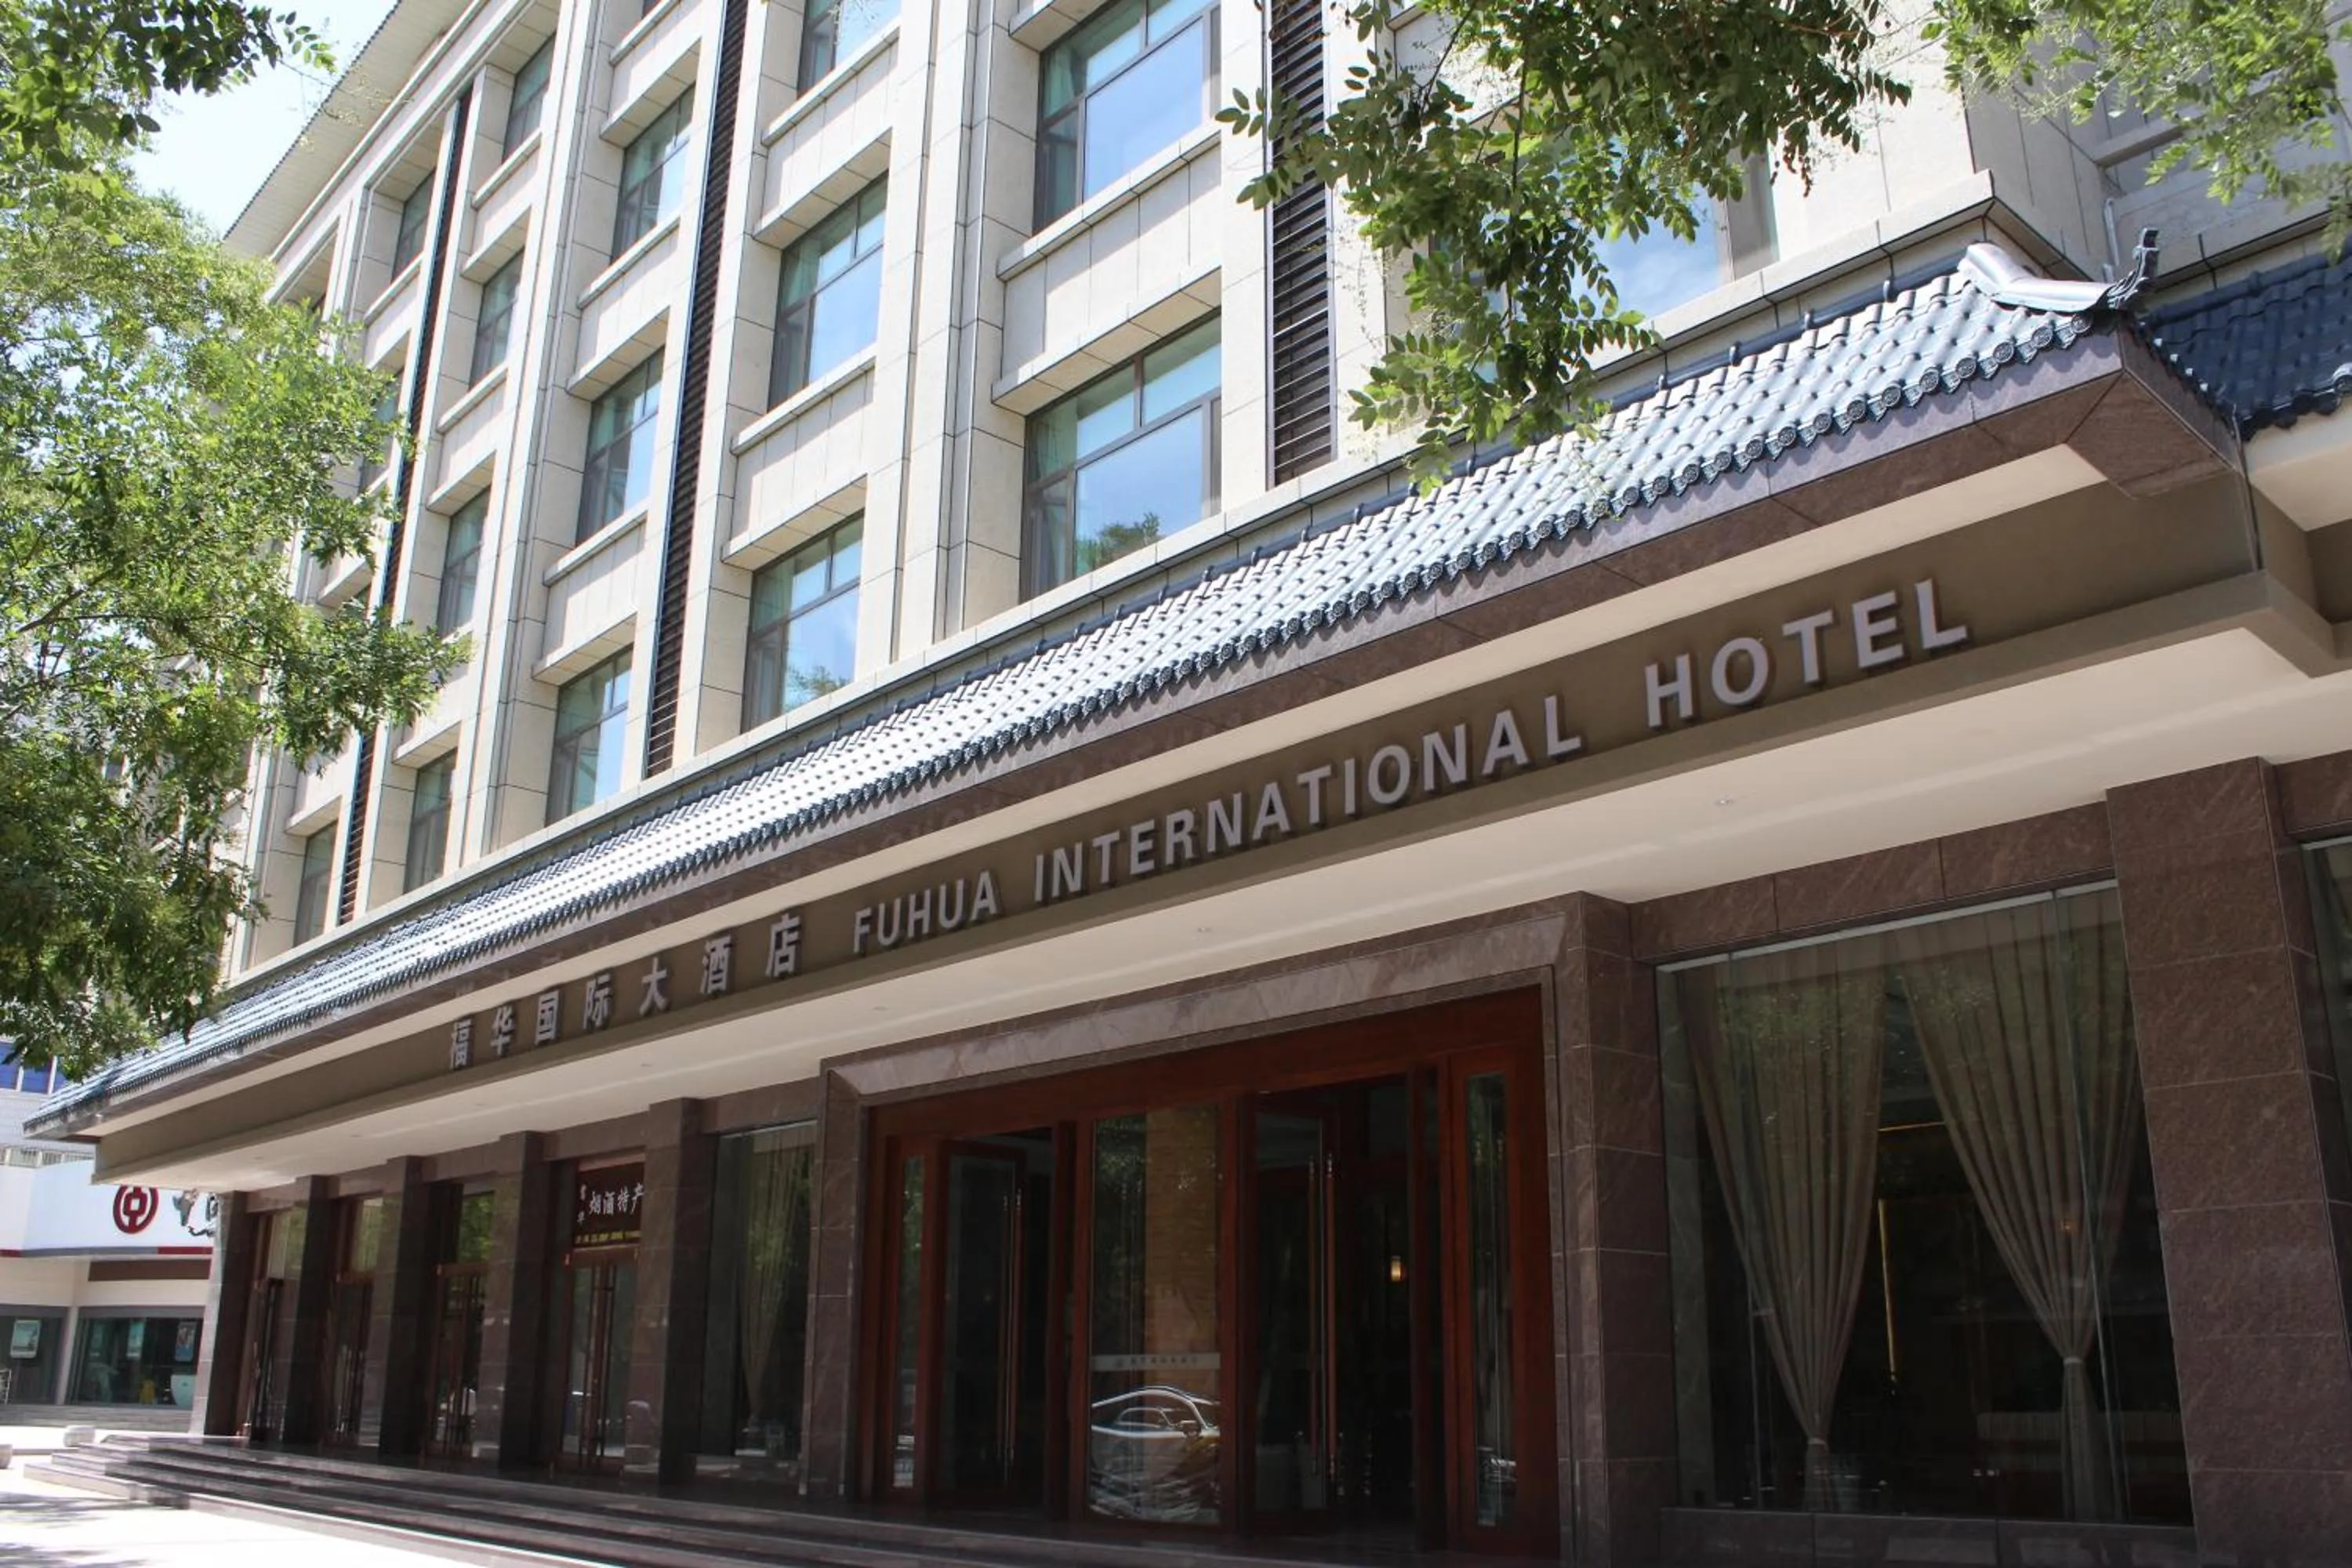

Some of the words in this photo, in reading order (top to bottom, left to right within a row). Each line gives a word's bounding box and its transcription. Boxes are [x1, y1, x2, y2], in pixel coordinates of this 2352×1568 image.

[853, 869, 1000, 954] FUHUA
[1033, 695, 1582, 902] INTERNATIONAL
[1644, 578, 1969, 728] HOTEL
[449, 913, 801, 1069] 福华国际大酒店
